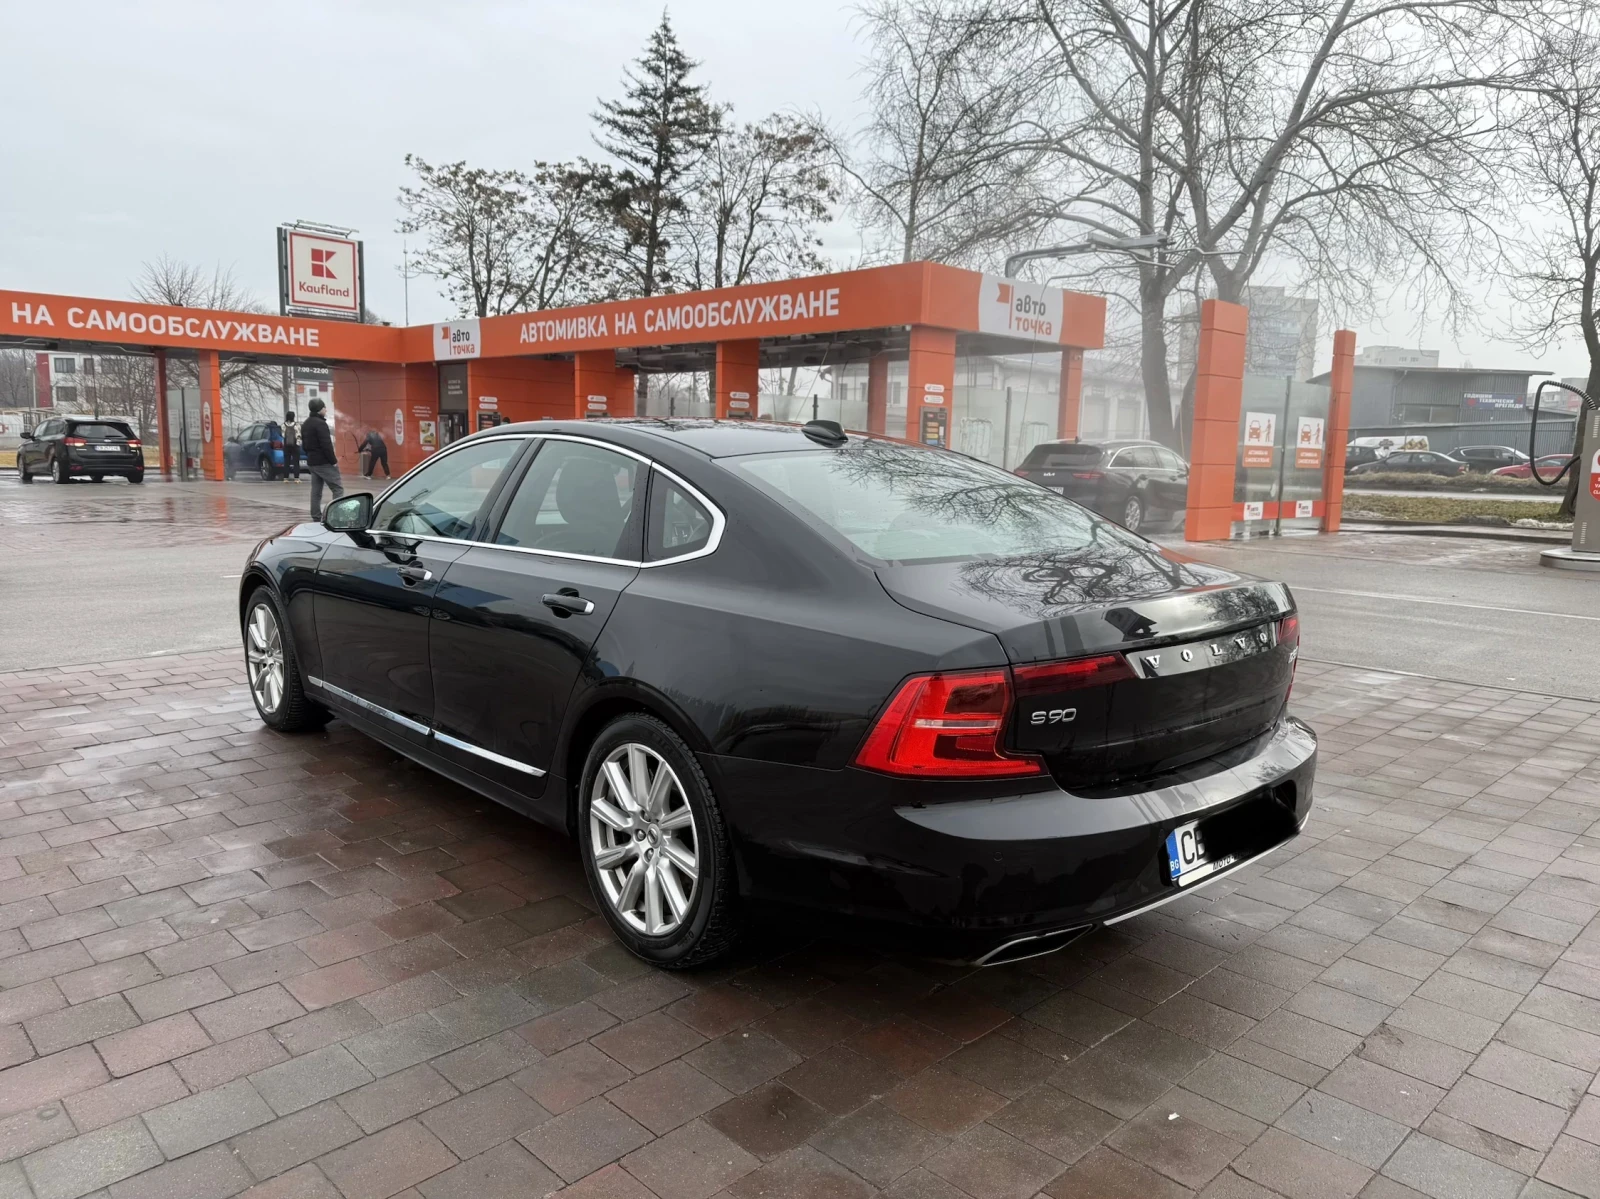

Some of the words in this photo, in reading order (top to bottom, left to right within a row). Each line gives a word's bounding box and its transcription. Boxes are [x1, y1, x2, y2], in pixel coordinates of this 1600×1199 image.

[299, 281, 350, 297] Kaufland
[11, 301, 55, 327] НА
[67, 307, 320, 347] САМООБСЛУЖВАНЕ
[520, 314, 609, 344] АВТОМИВКА
[615, 311, 638, 335] НА
[644, 287, 840, 333] САМООБСЛУЖВАНЕ
[1015, 316, 1052, 336] точка
[1146, 632, 1267, 669] VOLVO
[1030, 707, 1077, 725] S90
[1169, 858, 1180, 872] BG
